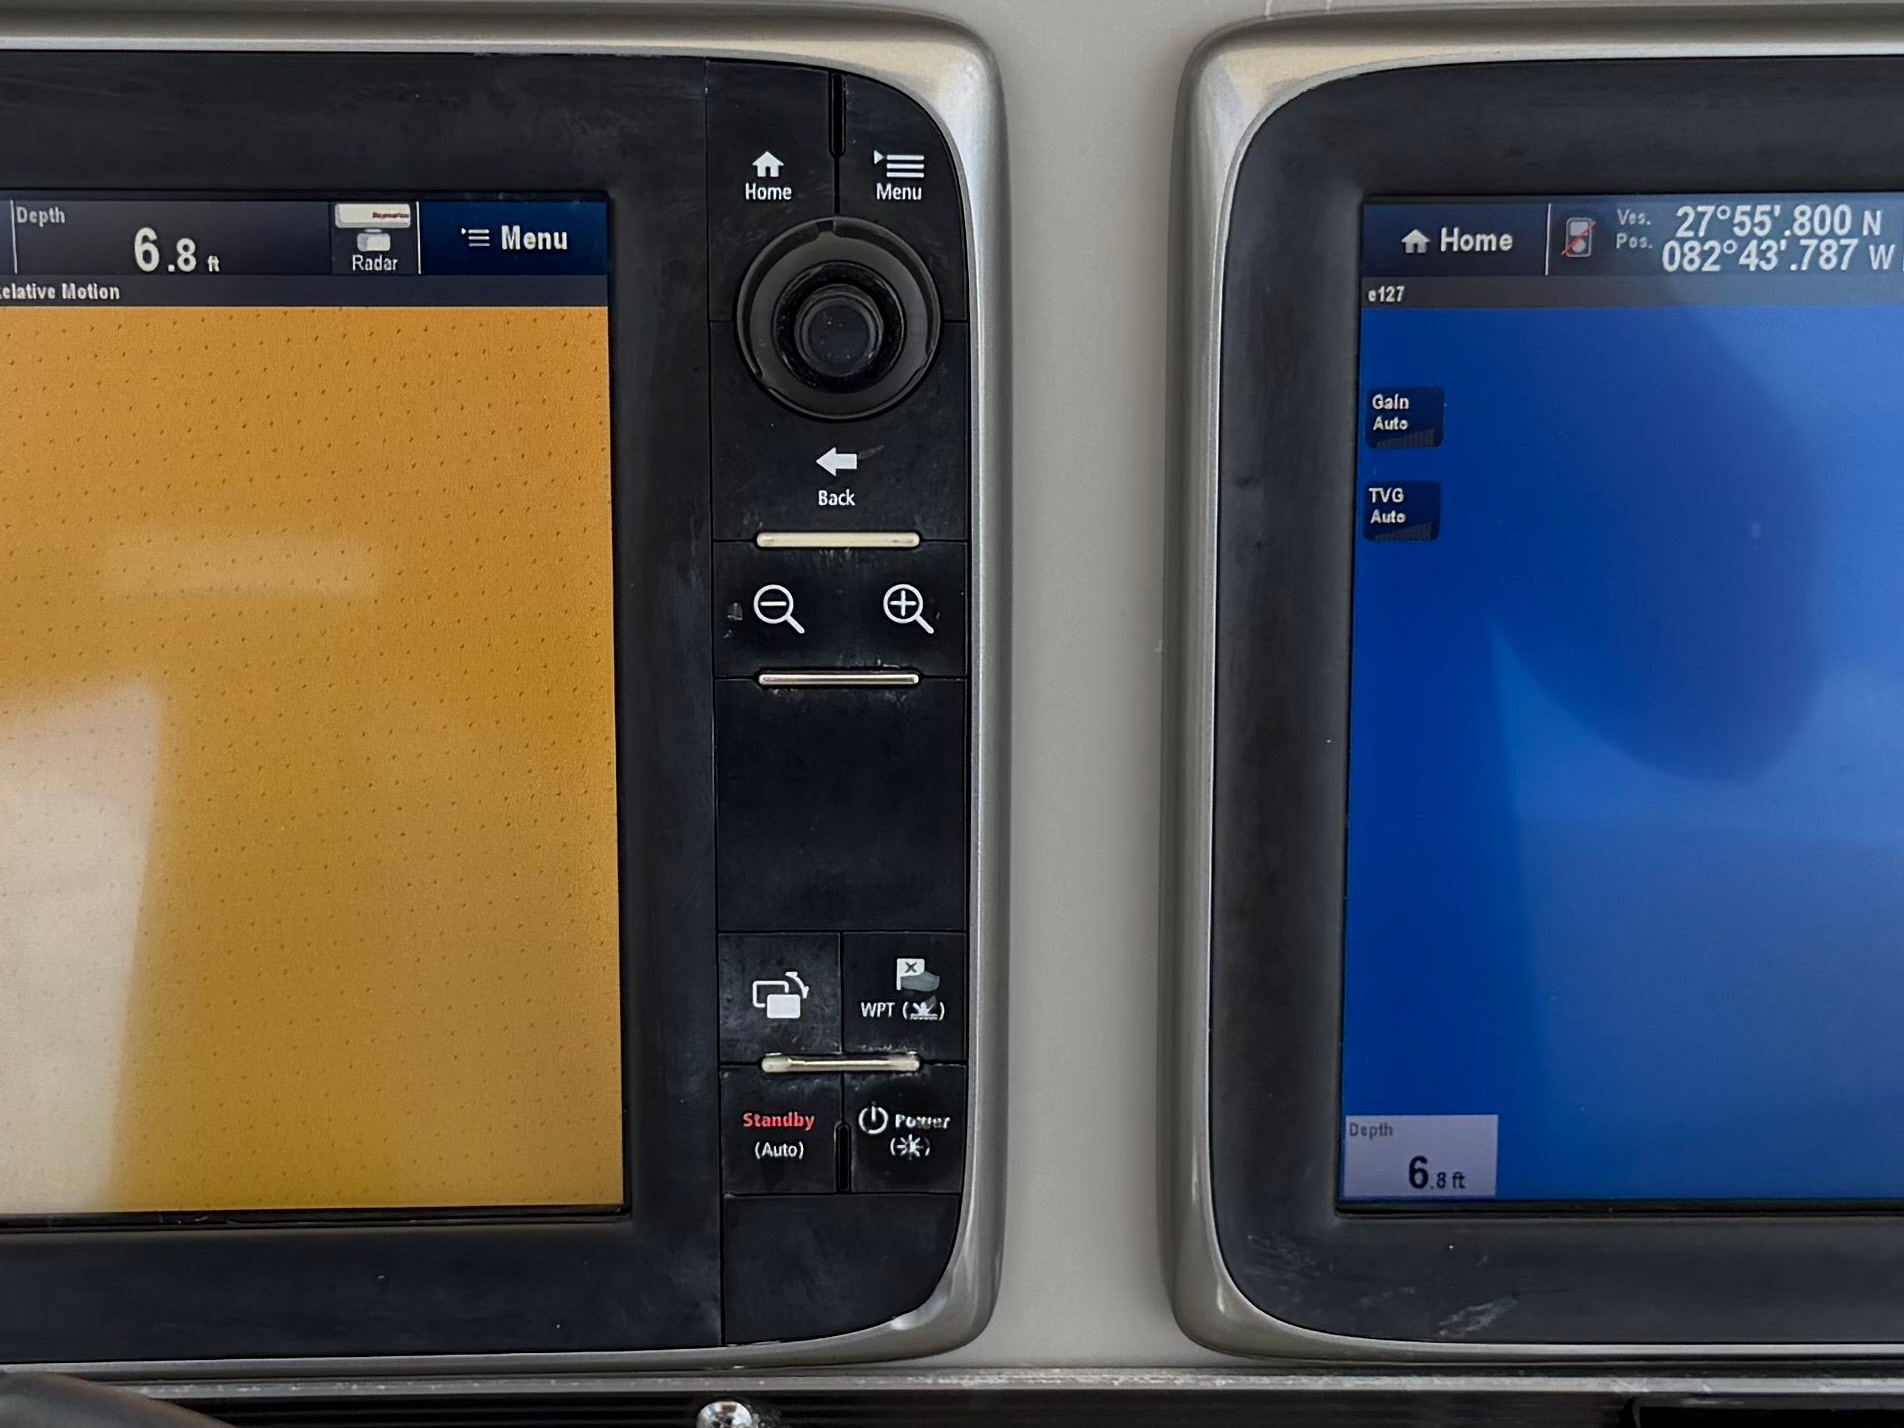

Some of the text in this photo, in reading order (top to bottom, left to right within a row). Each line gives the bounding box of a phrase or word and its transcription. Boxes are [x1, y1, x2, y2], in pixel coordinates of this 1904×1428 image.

[745, 182, 792, 202] Home
[876, 182, 923, 202] Menu
[16, 206, 66, 227] Depth
[1617, 209, 1652, 226] Ves.
[1862, 209, 1882, 236] N
[501, 225, 569, 251] Menu
[1440, 227, 1514, 254] Home
[1616, 233, 1654, 249] Pos.
[133, 226, 220, 273] 6.8 ft
[1869, 243, 1896, 270] W
[352, 254, 399, 272] Radar
[61, 282, 120, 300] Motion
[1368, 285, 1405, 304] e127
[1372, 393, 1410, 410] Gain
[1373, 416, 1409, 431] Auto
[818, 489, 856, 508] Back
[1368, 487, 1404, 503] TVG
[1370, 509, 1406, 524] Auto
[860, 1001, 895, 1019] WPT
[743, 1112, 816, 1133] Standby
[1349, 1122, 1394, 1139] Depth
[754, 1141, 805, 1160] (Auto)
[1408, 1155, 1466, 1190] 6.8 ft
